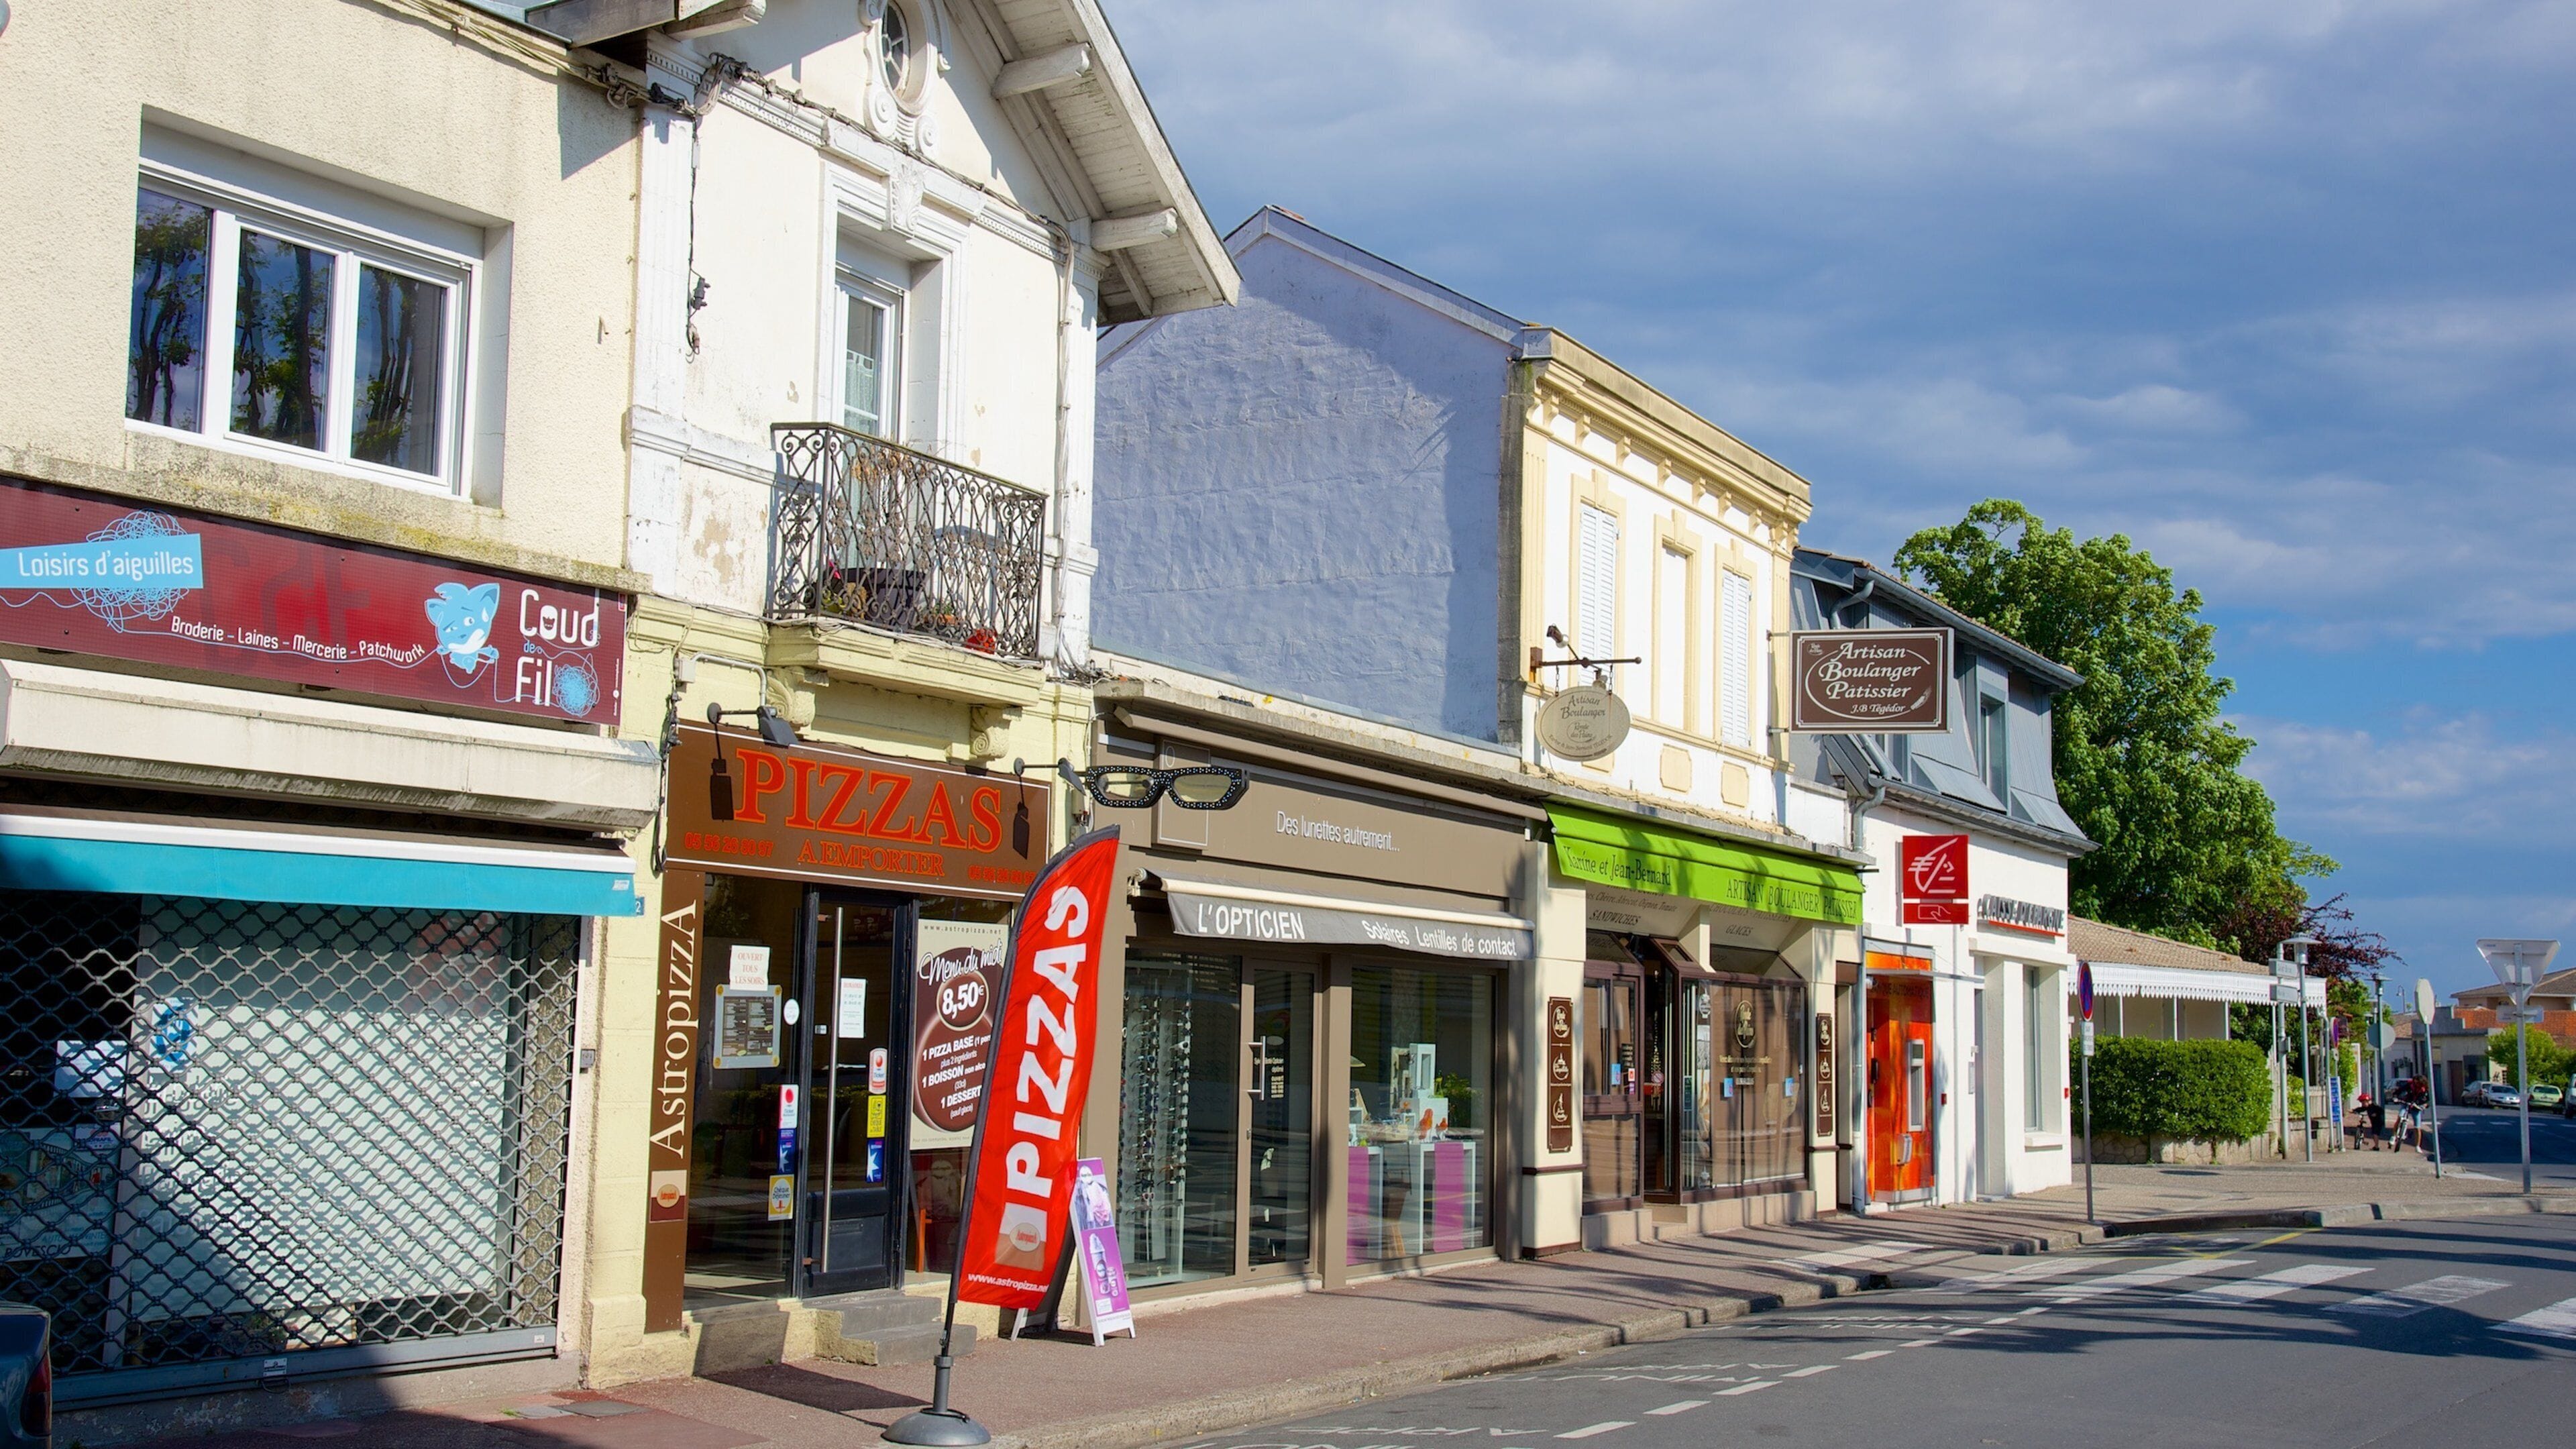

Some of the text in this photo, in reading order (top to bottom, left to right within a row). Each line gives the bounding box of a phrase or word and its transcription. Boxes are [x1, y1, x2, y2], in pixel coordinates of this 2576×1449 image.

[18, 549, 194, 582] Loisirs d'aiguilles
[519, 588, 600, 647] Coud
[171, 615, 426, 663] Broderie Laines Mercerie Patchwork
[1831, 641, 1906, 661] Artisan
[515, 655, 553, 707] Fil
[1818, 660, 1921, 682] Boulanger
[1568, 695, 1601, 706] Artisan
[1826, 680, 1912, 699] Pâtissier
[1560, 706, 1606, 720] Boulanger
[733, 748, 1003, 853] PIZZAS
[684, 831, 702, 849] 05
[704, 834, 720, 852] 56
[757, 840, 773, 858] 97
[1277, 810, 1400, 852] Des lunettes autrement...
[797, 839, 945, 877] A EMPORTER
[1563, 845, 1672, 886] Karine et Jean-Bernard
[1726, 878, 1858, 919] ARTISAN BOULANGER PATISSIER
[924, 925, 1002, 935] www.astropizza.net
[1197, 902, 1305, 940] L'OPTICIEN
[1589, 909, 1641, 926] SANDWICHES
[1725, 924, 1754, 936] GLACES
[1362, 920, 1517, 957] Solaires Lentilles de contact
[738, 953, 763, 961] OUVERT
[919, 938, 1003, 985] Menu du midi
[942, 981, 985, 1019] 8,50€
[922, 1049, 928, 1061] 1
[928, 1042, 953, 1060] PIZZA
[953, 1035, 975, 1052] BASE
[1006, 885, 1089, 1199] PIZZAS
[951, 1055, 955, 1064] 2
[922, 1077, 928, 1088] 1
[928, 1065, 965, 1087] BOISSON
[964, 1067, 975, 1075] non
[941, 1085, 983, 1109] 1 DESSERT
[967, 1272, 1049, 1294] www.astropizza.net
